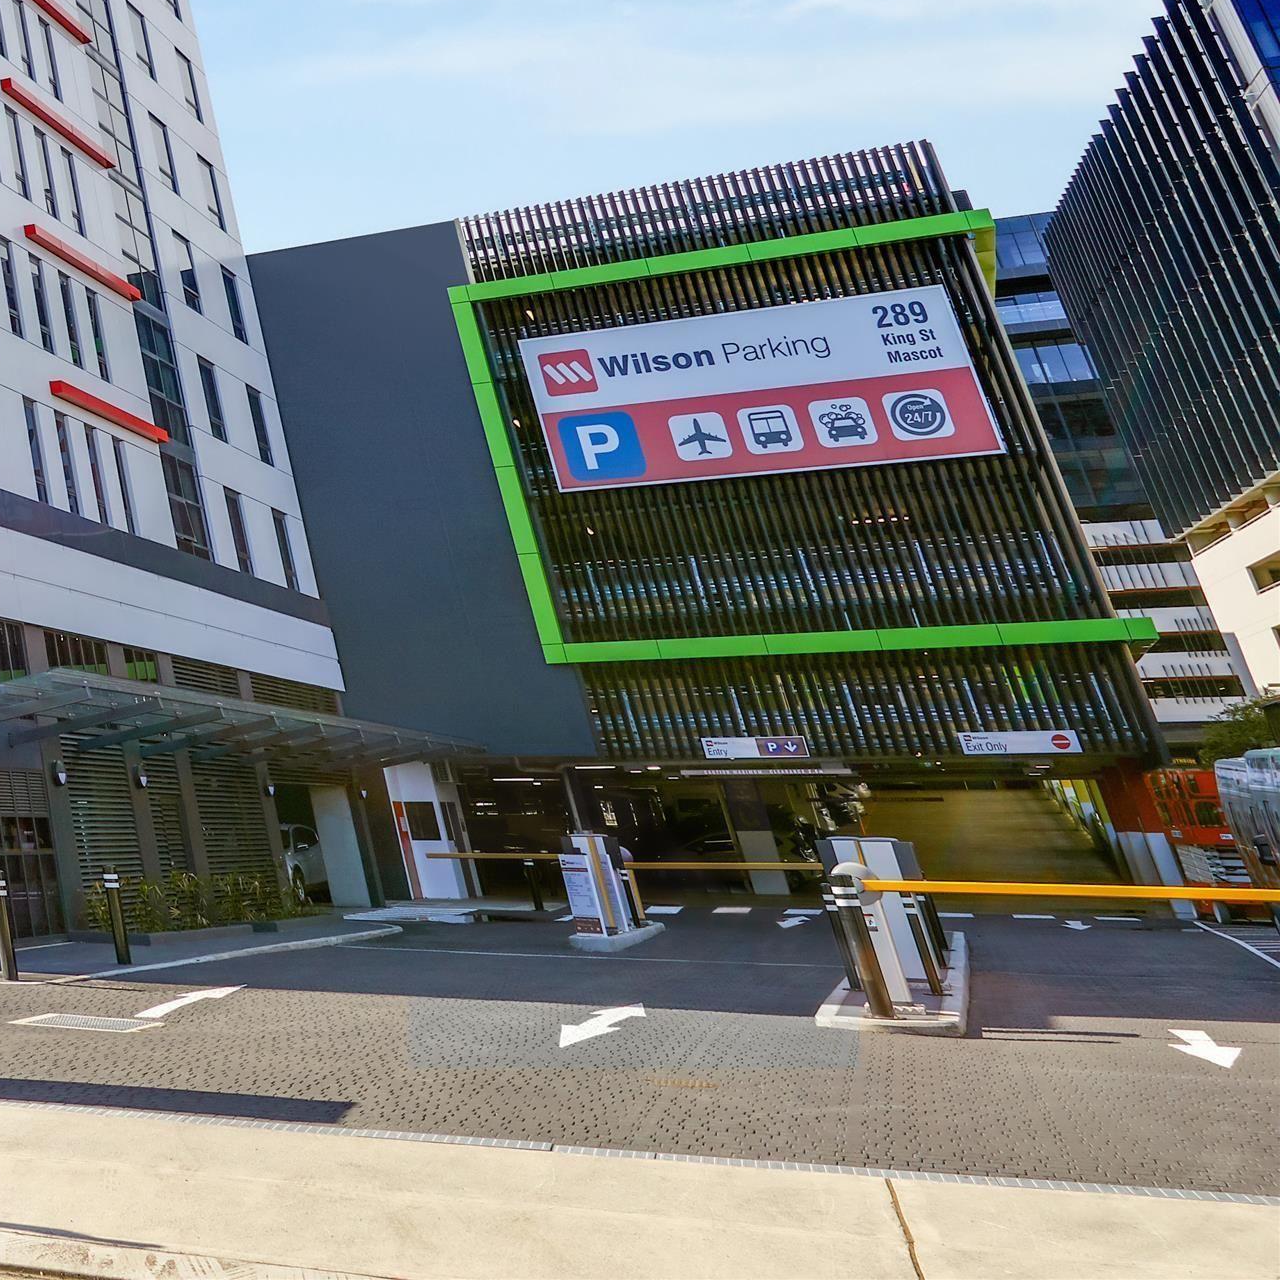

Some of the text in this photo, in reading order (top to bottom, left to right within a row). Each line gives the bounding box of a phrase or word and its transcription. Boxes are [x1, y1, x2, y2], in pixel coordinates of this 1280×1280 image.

[871, 300, 929, 329] 289
[881, 328, 937, 346] King St
[597, 335, 831, 378] Wilson Parking
[886, 345, 944, 364] Mascot
[904, 410, 932, 424] 24/7
[575, 422, 620, 471] P
[707, 741, 777, 757] Entry P
[965, 741, 1008, 753] Exit Only
